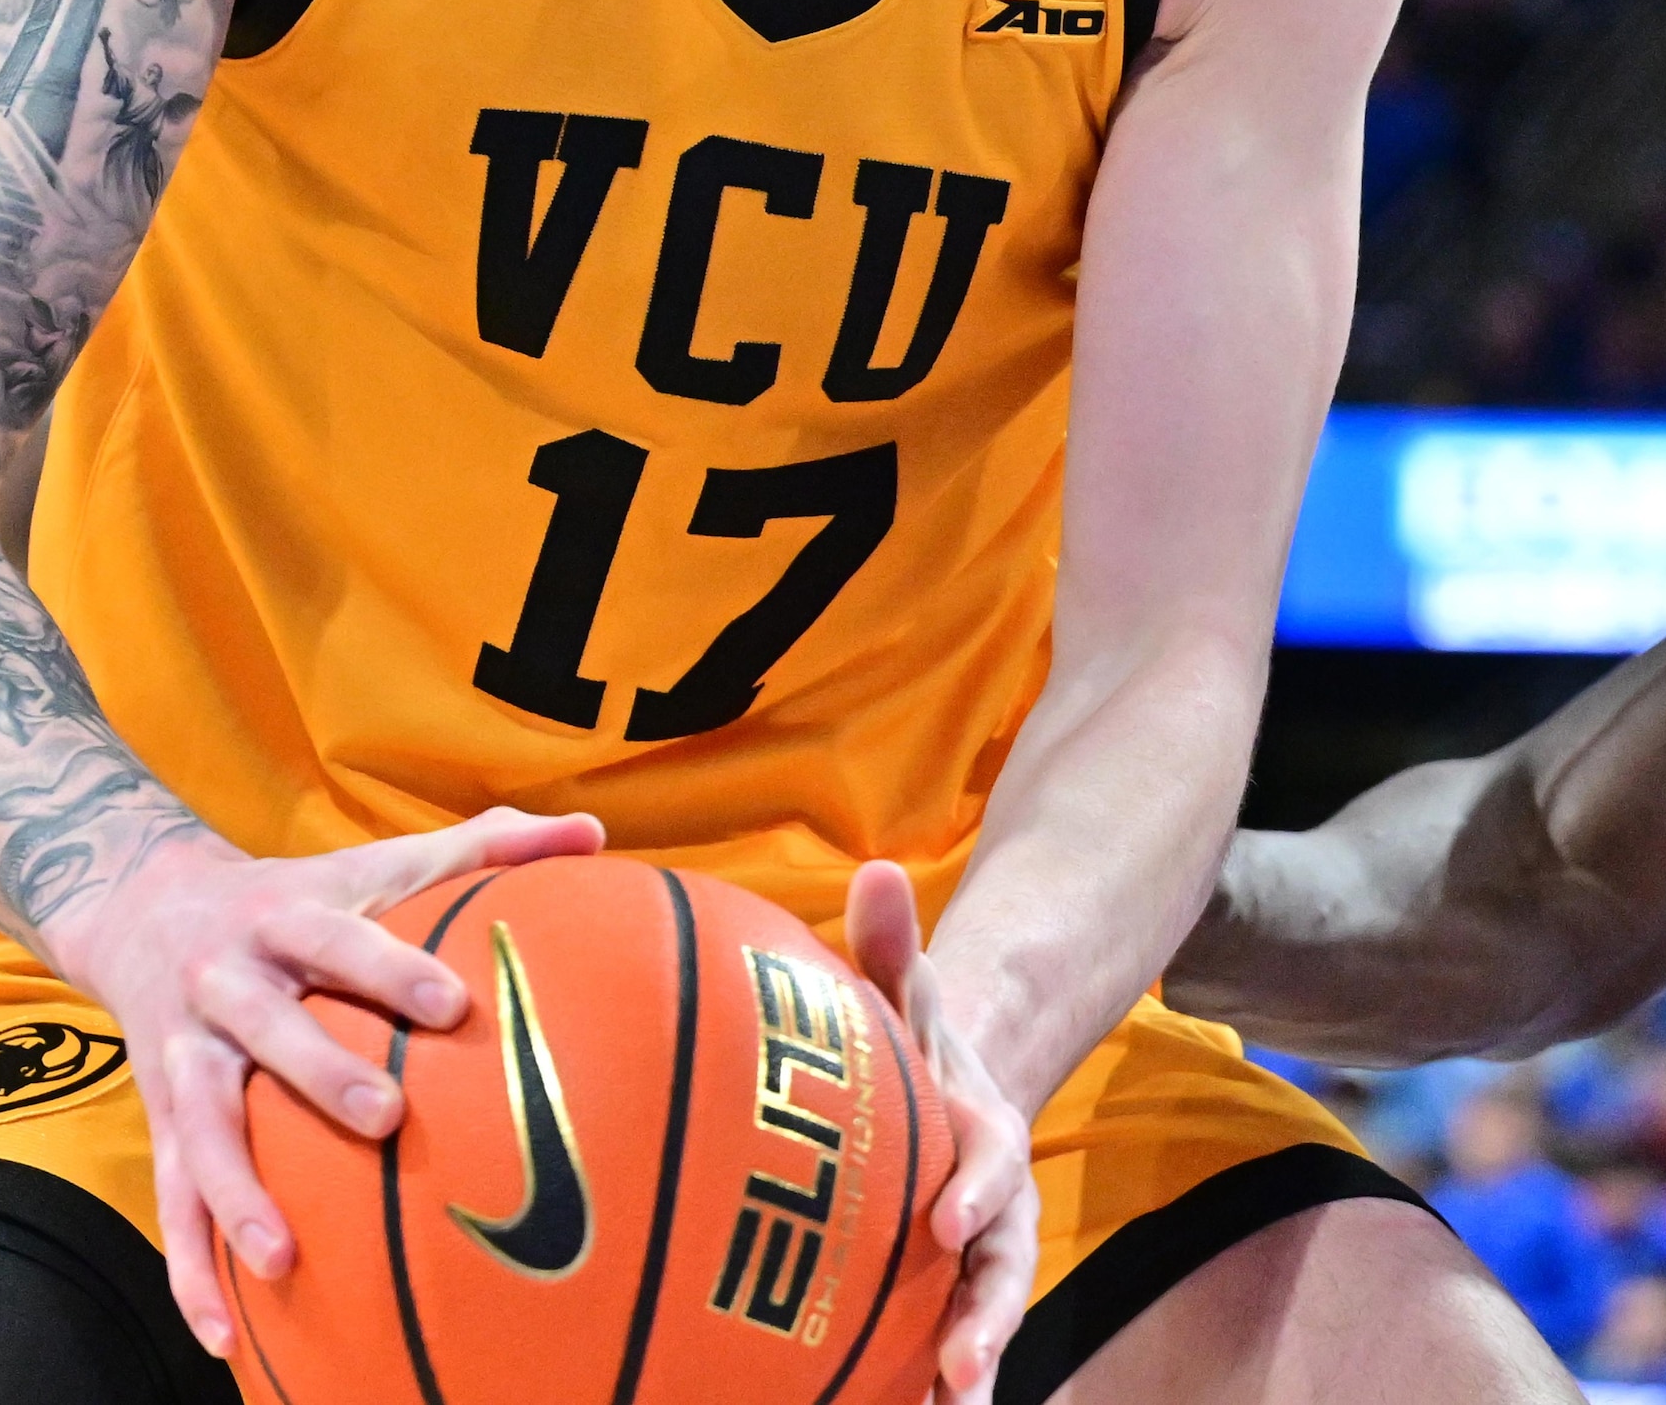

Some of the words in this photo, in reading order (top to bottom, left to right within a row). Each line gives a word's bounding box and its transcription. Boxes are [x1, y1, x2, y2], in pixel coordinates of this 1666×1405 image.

[470, 107, 1011, 406] VCU
[472, 429, 899, 742] 17
[707, 944, 851, 1340] ELITE
